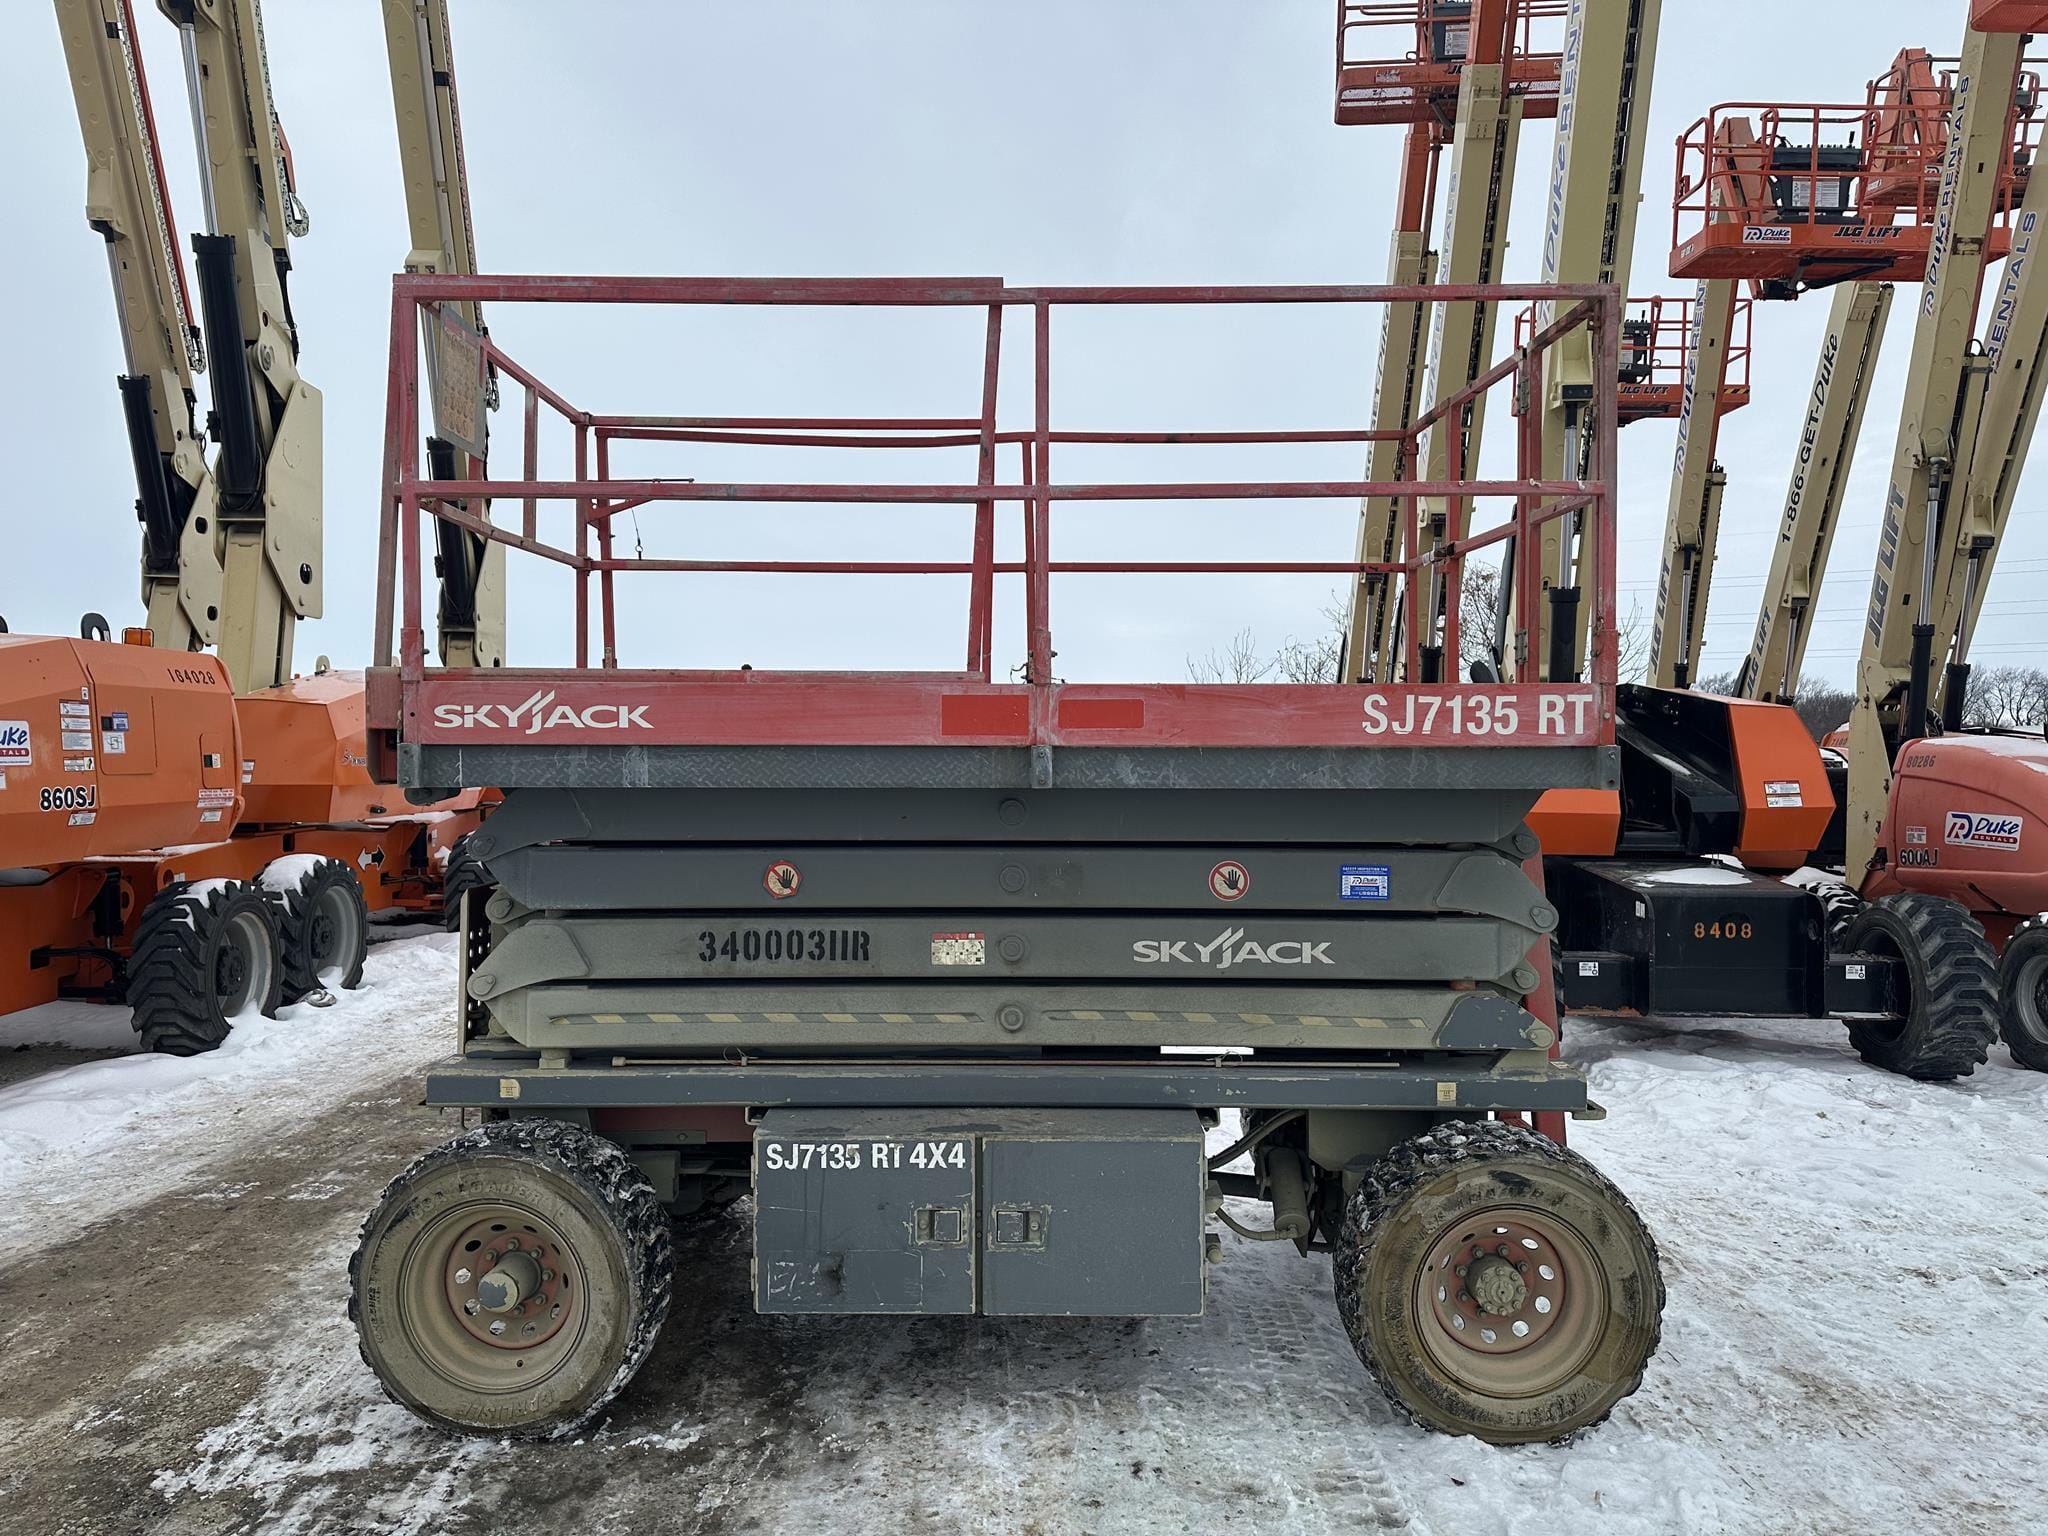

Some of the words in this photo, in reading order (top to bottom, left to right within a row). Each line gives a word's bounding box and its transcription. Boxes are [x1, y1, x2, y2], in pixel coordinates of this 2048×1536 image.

[1941, 76, 1970, 207] RENTALS
[1834, 226, 1864, 237] JLG
[1867, 226, 1902, 238] LIFT
[1620, 385, 1640, 394] JLG
[1643, 386, 1669, 395] LIFT
[1868, 575, 1889, 649] JLG
[1880, 480, 1905, 573] LIFT
[1650, 623, 1662, 676] JLG
[1657, 558, 1670, 620] LIFT
[1747, 656, 1759, 699] JLG
[1756, 605, 1771, 657] LIFT
[433, 689, 655, 735] SKYJACK
[1362, 693, 1519, 735] SJ7135
[1538, 694, 1593, 735] RT
[1905, 755, 1937, 768] 80286
[40, 785, 97, 811] 860SJ
[1974, 834, 2015, 843] RENTALS
[1899, 848, 1939, 867] 600AJ
[1693, 922, 1752, 939] 8408
[1133, 927, 1336, 969] SKYJACK
[766, 1143, 861, 1169] SJ7135
[872, 1143, 904, 1169] RT
[909, 1142, 966, 1169] 4X4
